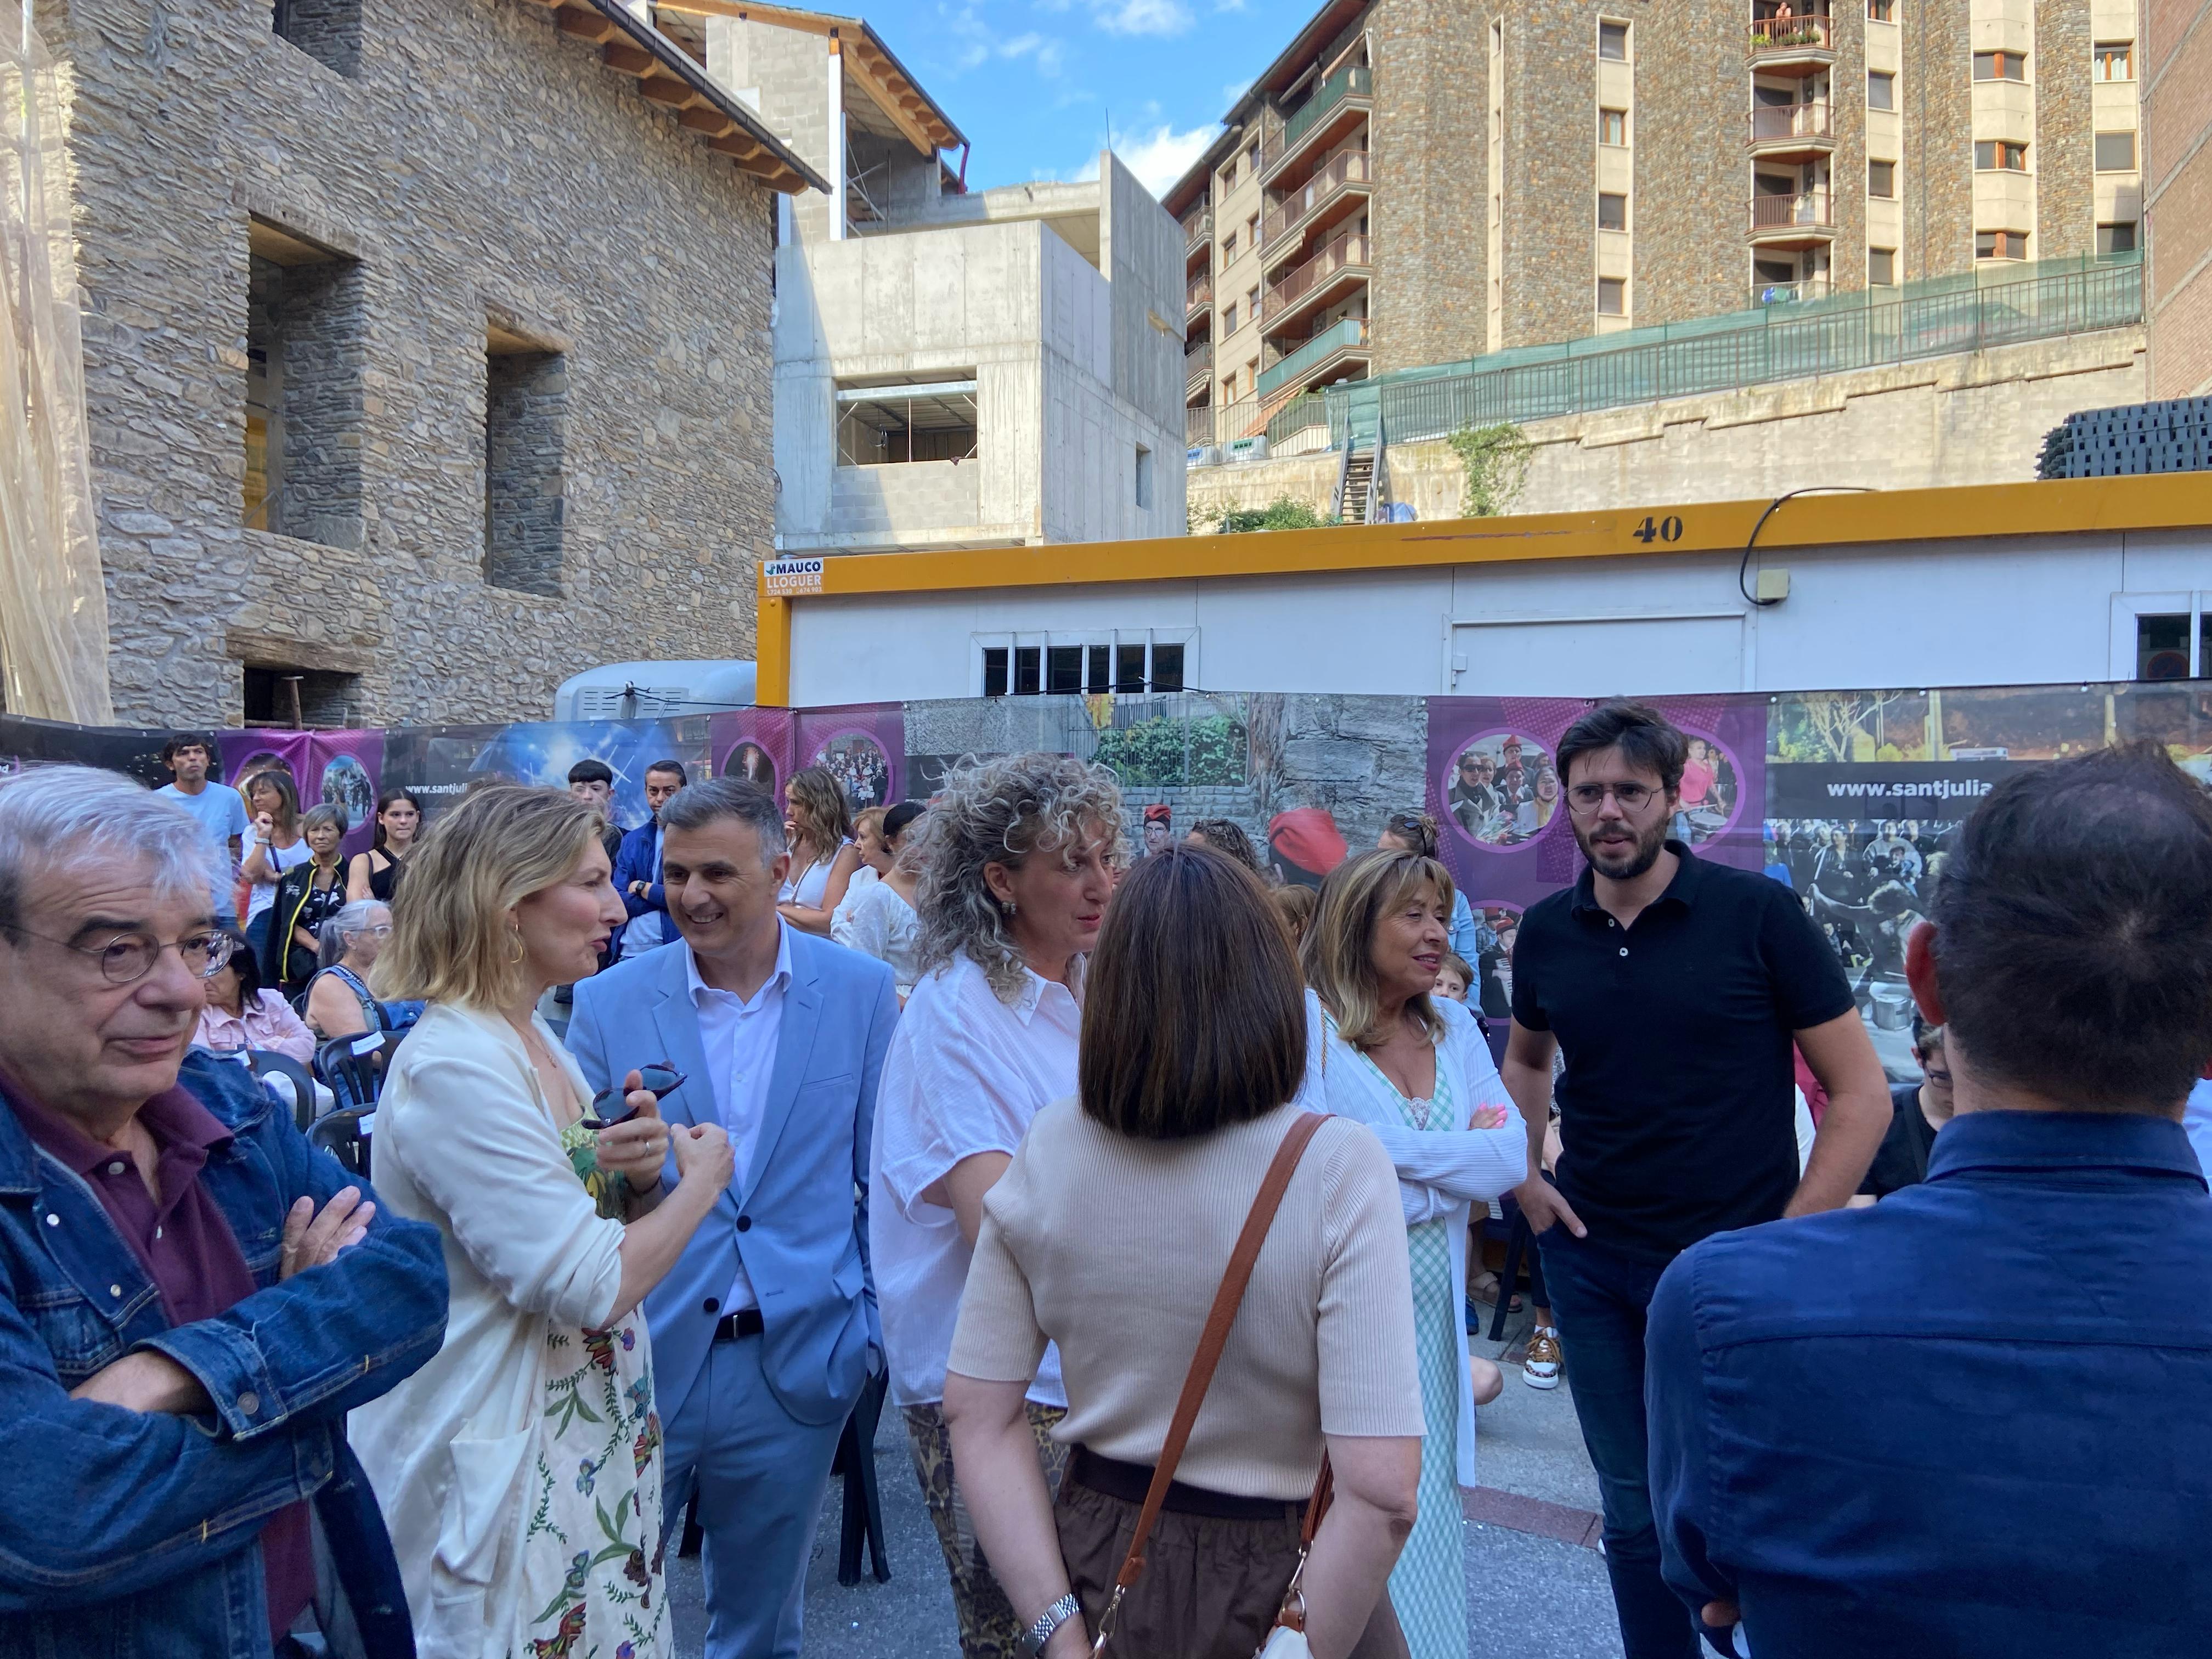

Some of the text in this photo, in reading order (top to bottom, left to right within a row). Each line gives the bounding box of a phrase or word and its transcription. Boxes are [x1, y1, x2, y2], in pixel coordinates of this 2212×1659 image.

[1633, 516, 1683, 543] 40
[776, 561, 821, 574] MAUCO
[767, 575, 821, 588] LLOGUER
